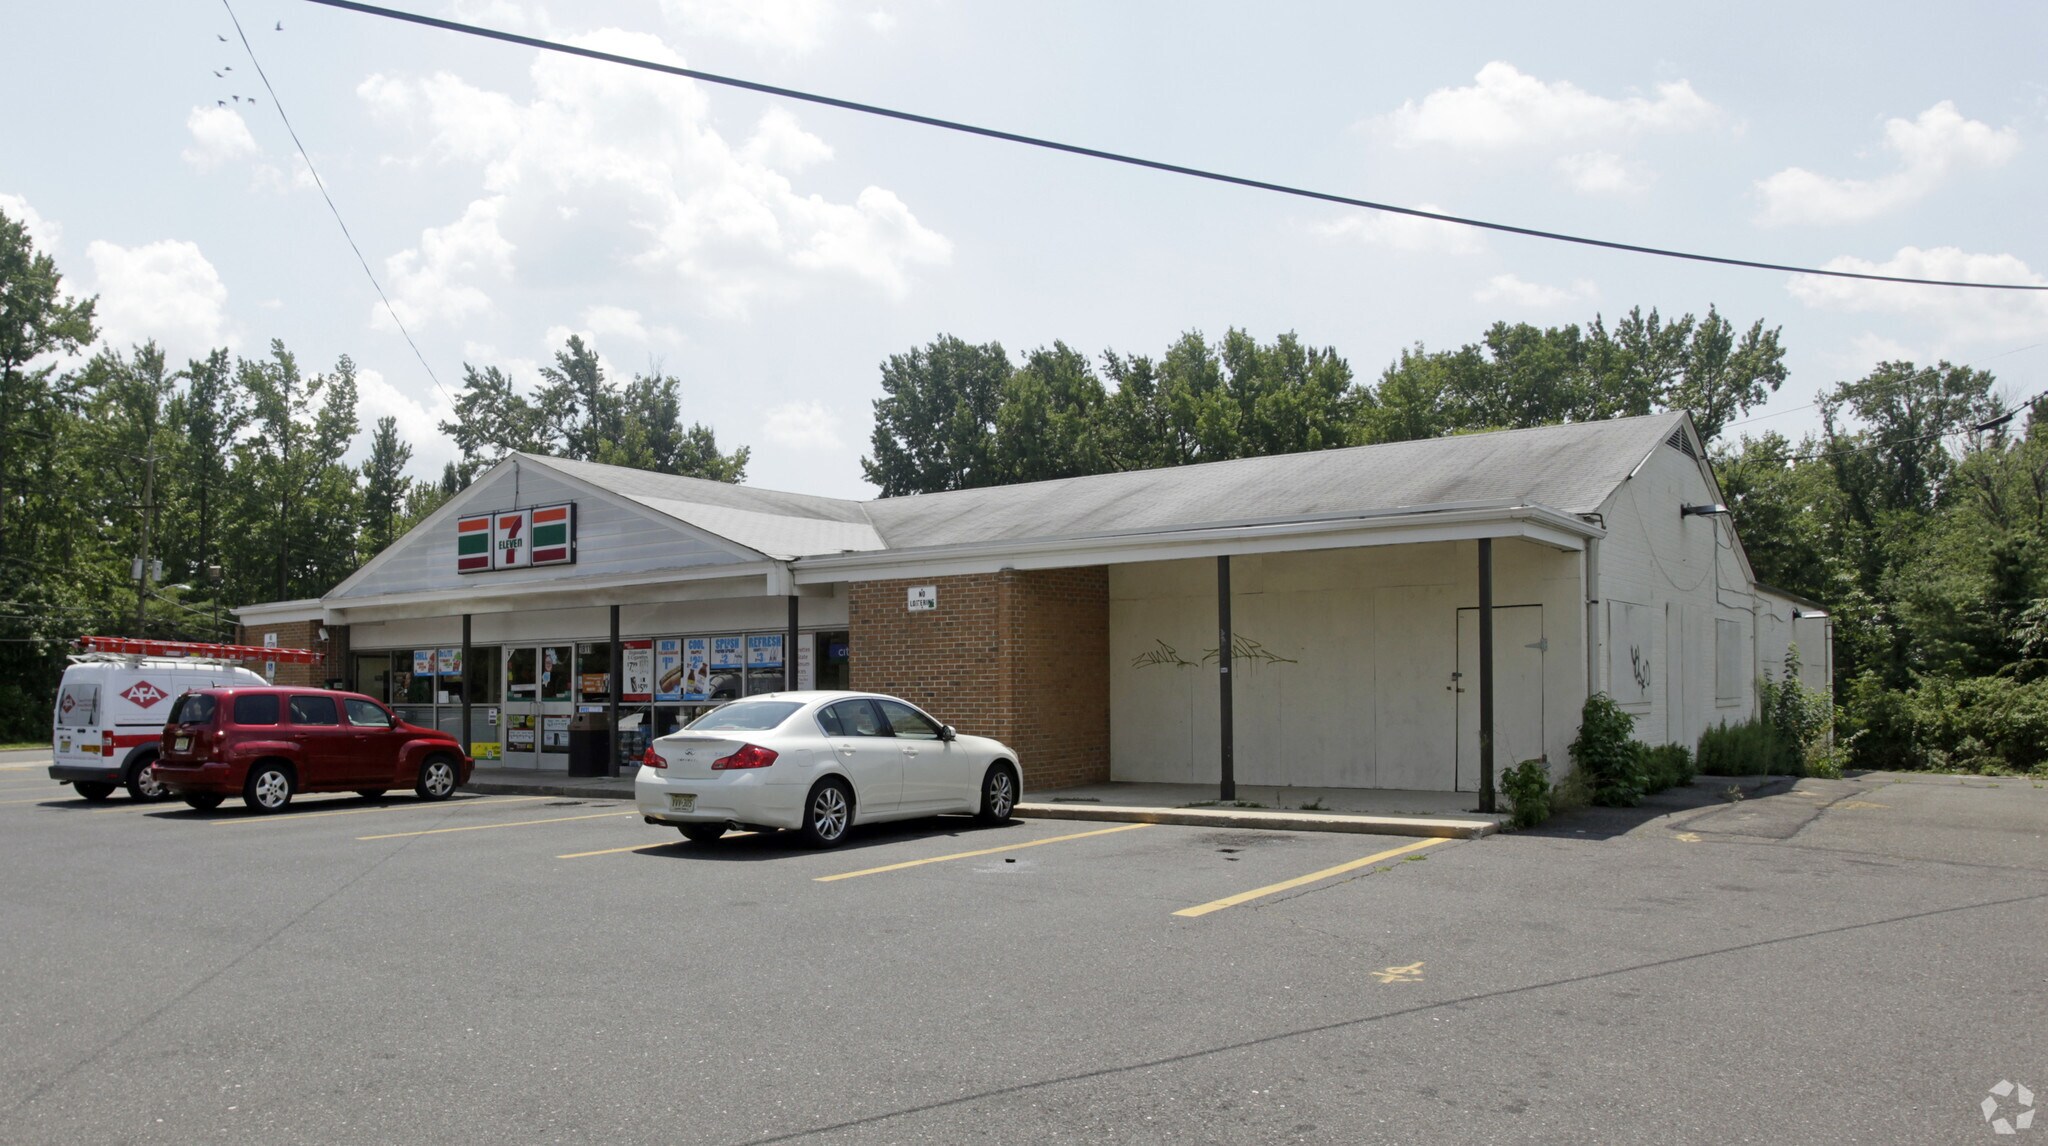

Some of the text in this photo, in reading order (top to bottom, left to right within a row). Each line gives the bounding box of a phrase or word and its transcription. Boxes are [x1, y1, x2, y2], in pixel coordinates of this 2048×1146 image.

[499, 515, 522, 564] 7
[909, 599, 935, 608] LOITERI
[661, 640, 675, 651] NEW
[688, 639, 705, 649] COOL
[748, 635, 781, 648] REFRESH
[127, 686, 162, 703] AFA
